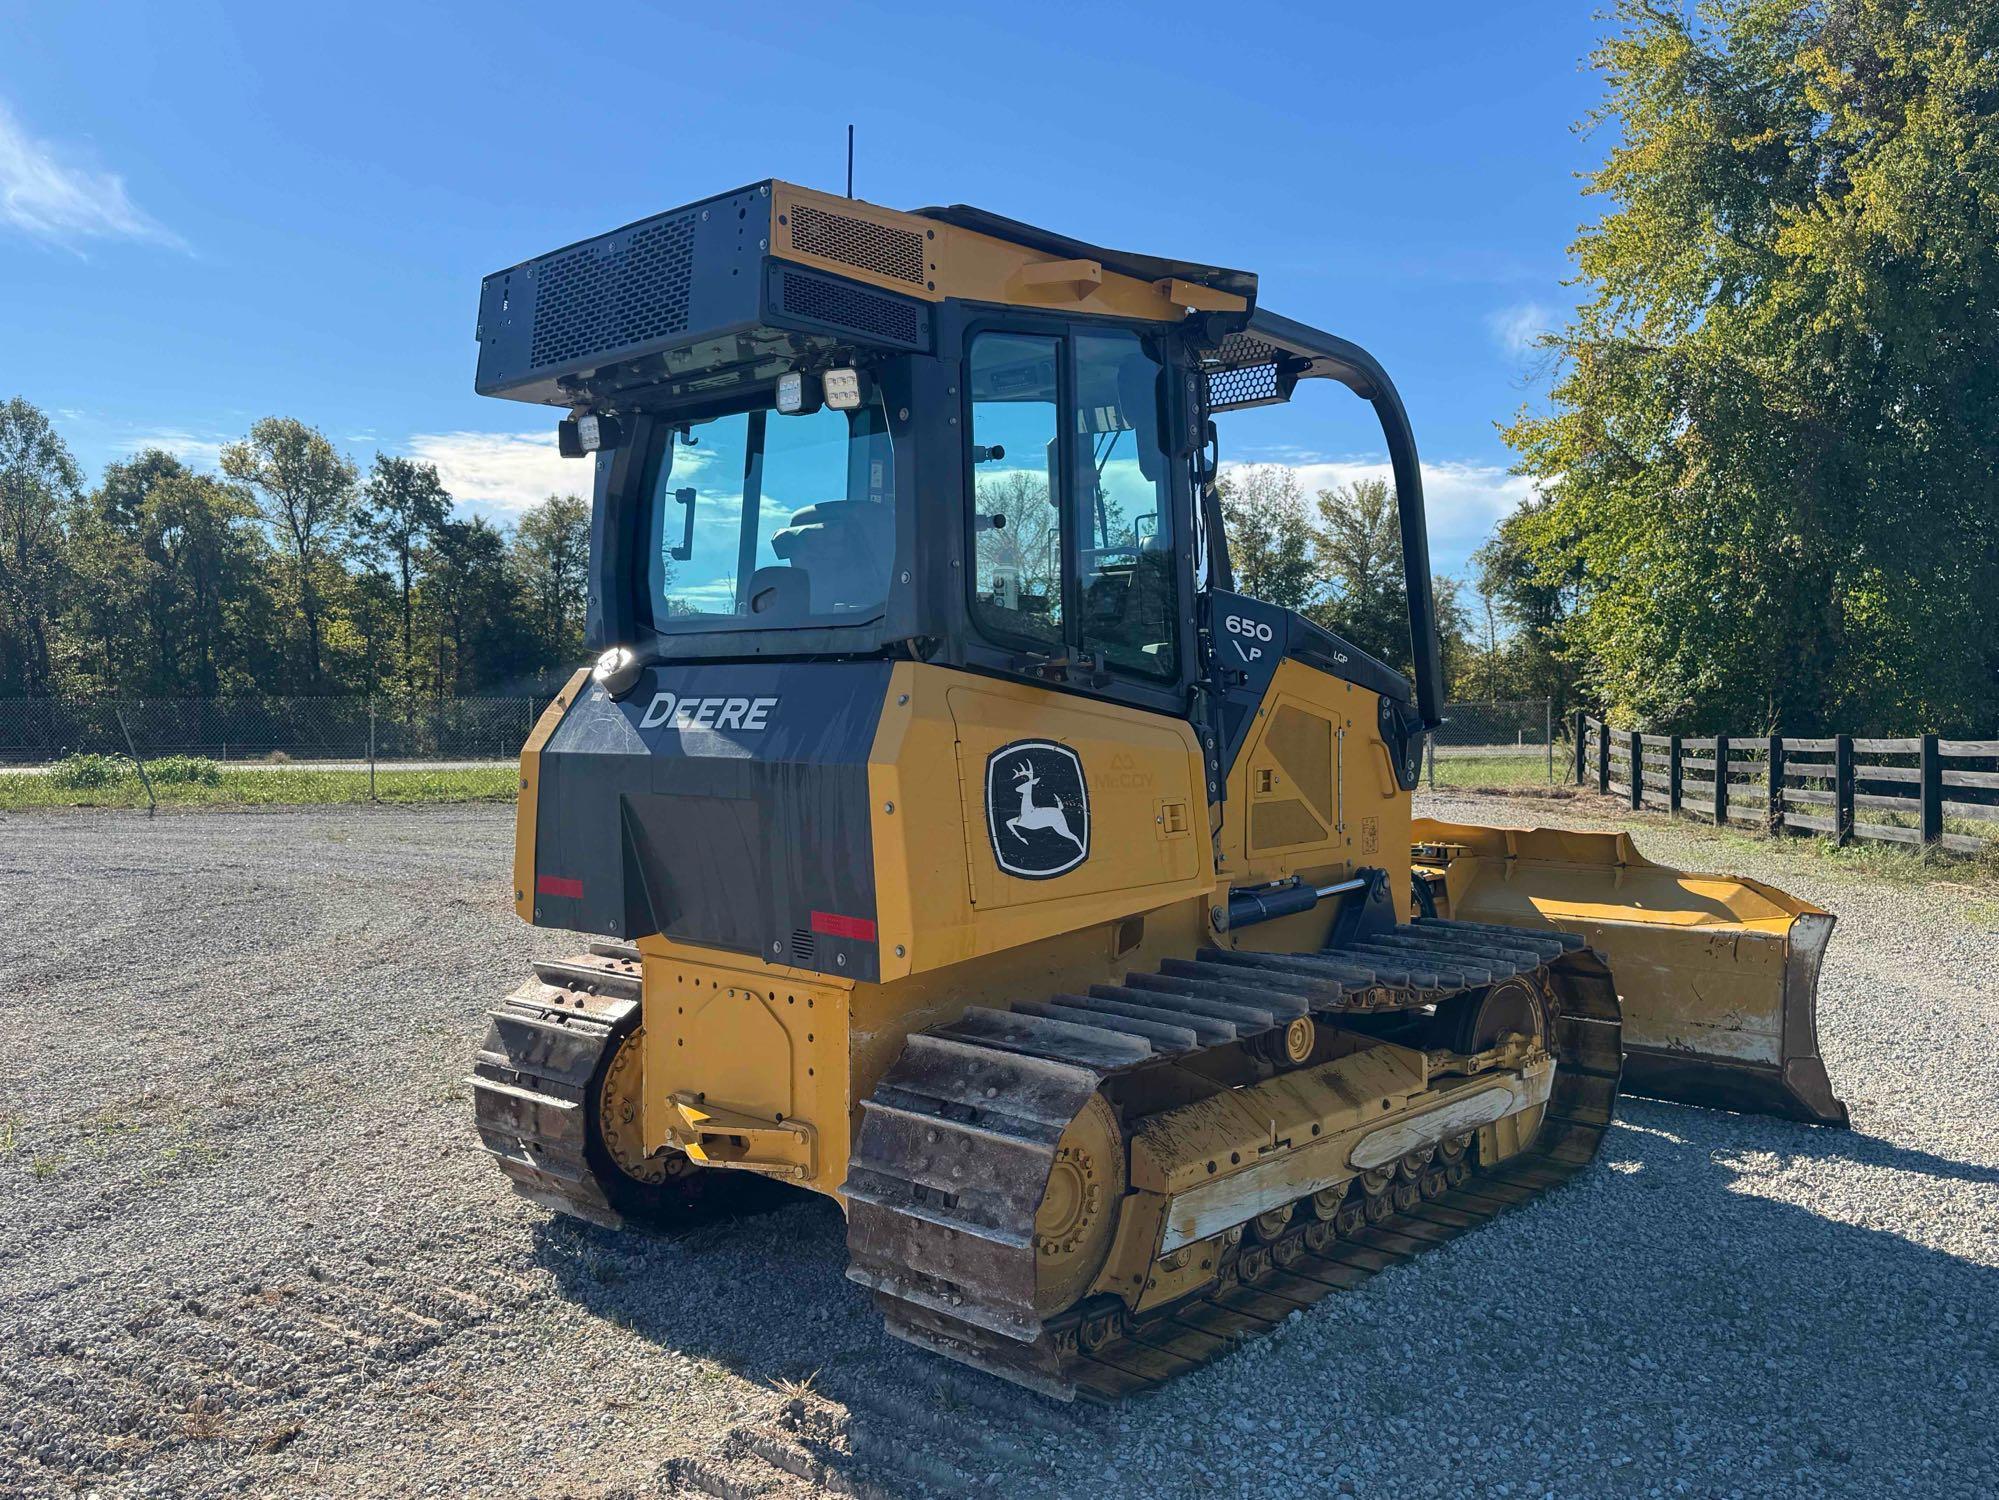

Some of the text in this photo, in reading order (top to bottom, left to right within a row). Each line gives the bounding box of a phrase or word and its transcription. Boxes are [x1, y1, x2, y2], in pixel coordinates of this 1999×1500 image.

[1225, 615, 1273, 642] 650
[1333, 650, 1348, 664] LGP
[639, 692, 777, 730] DEERE
